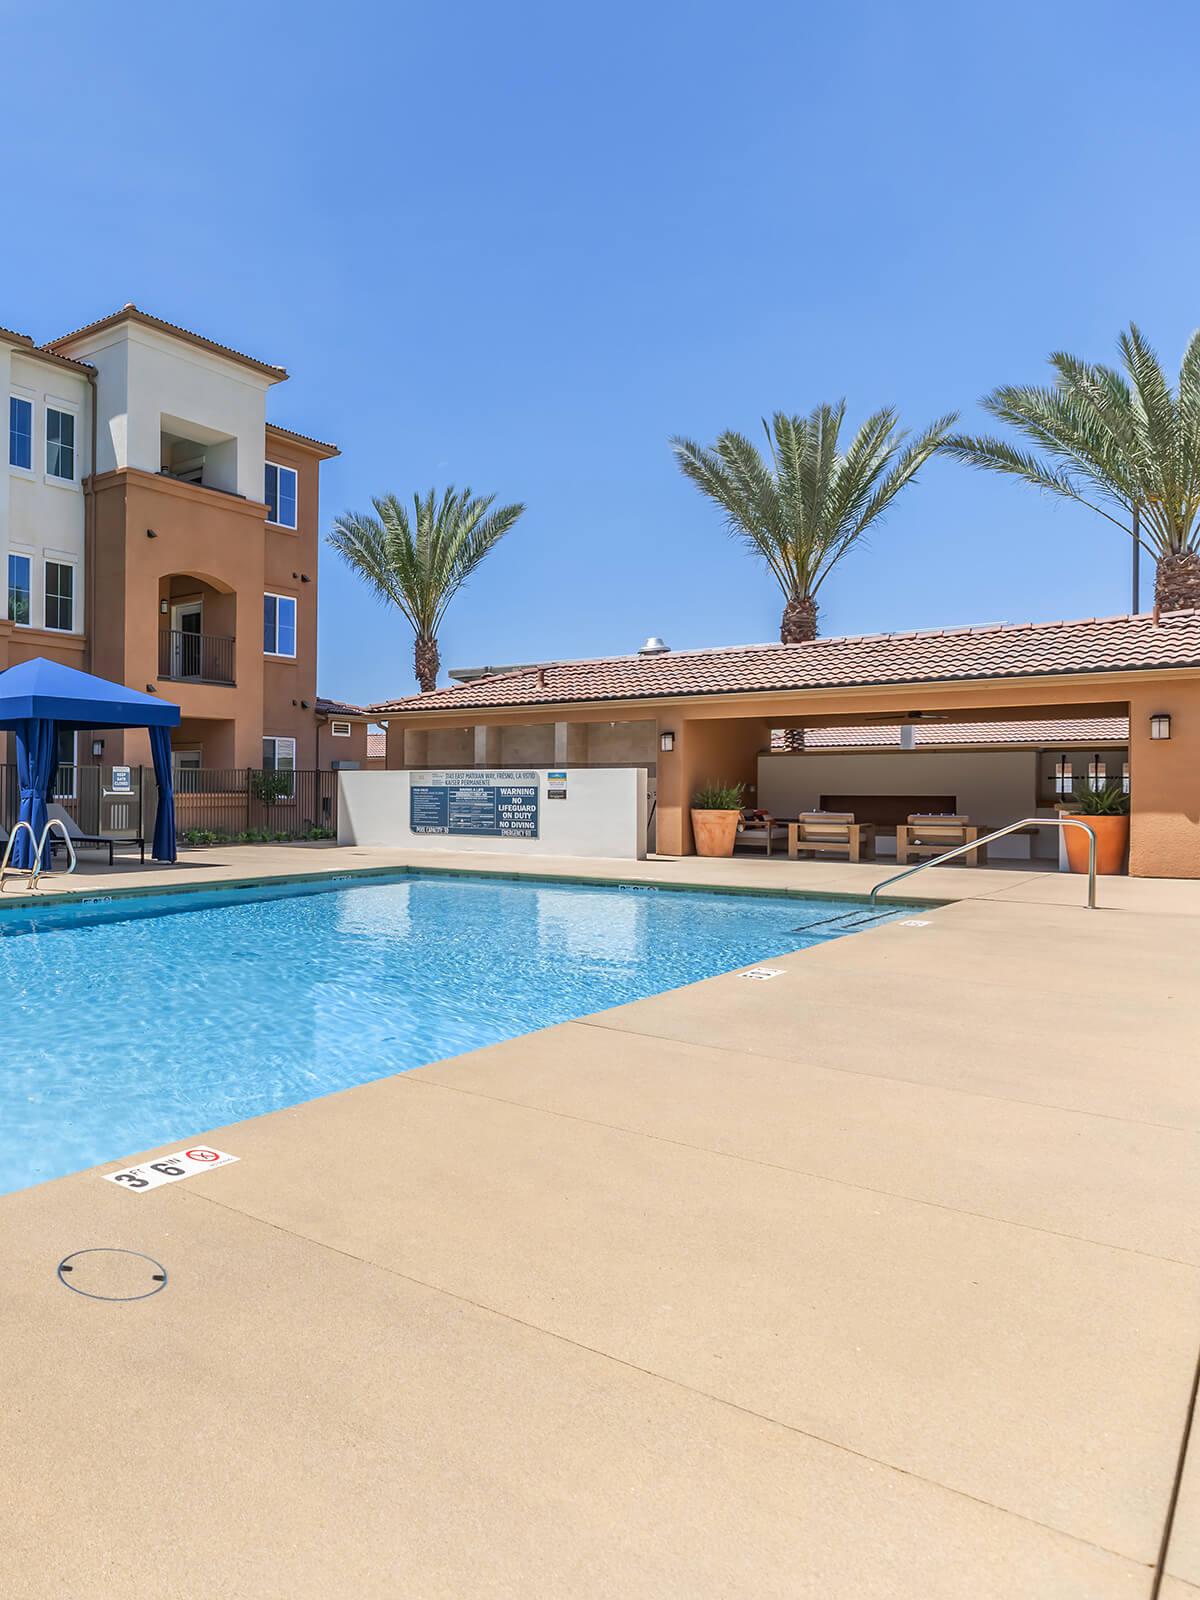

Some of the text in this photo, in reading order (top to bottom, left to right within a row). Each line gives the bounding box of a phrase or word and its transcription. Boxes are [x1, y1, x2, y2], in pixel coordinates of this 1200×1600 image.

[496, 772, 515, 780] FRESNO,
[114, 1174, 149, 1187] 3
[150, 1163, 185, 1176] 6
